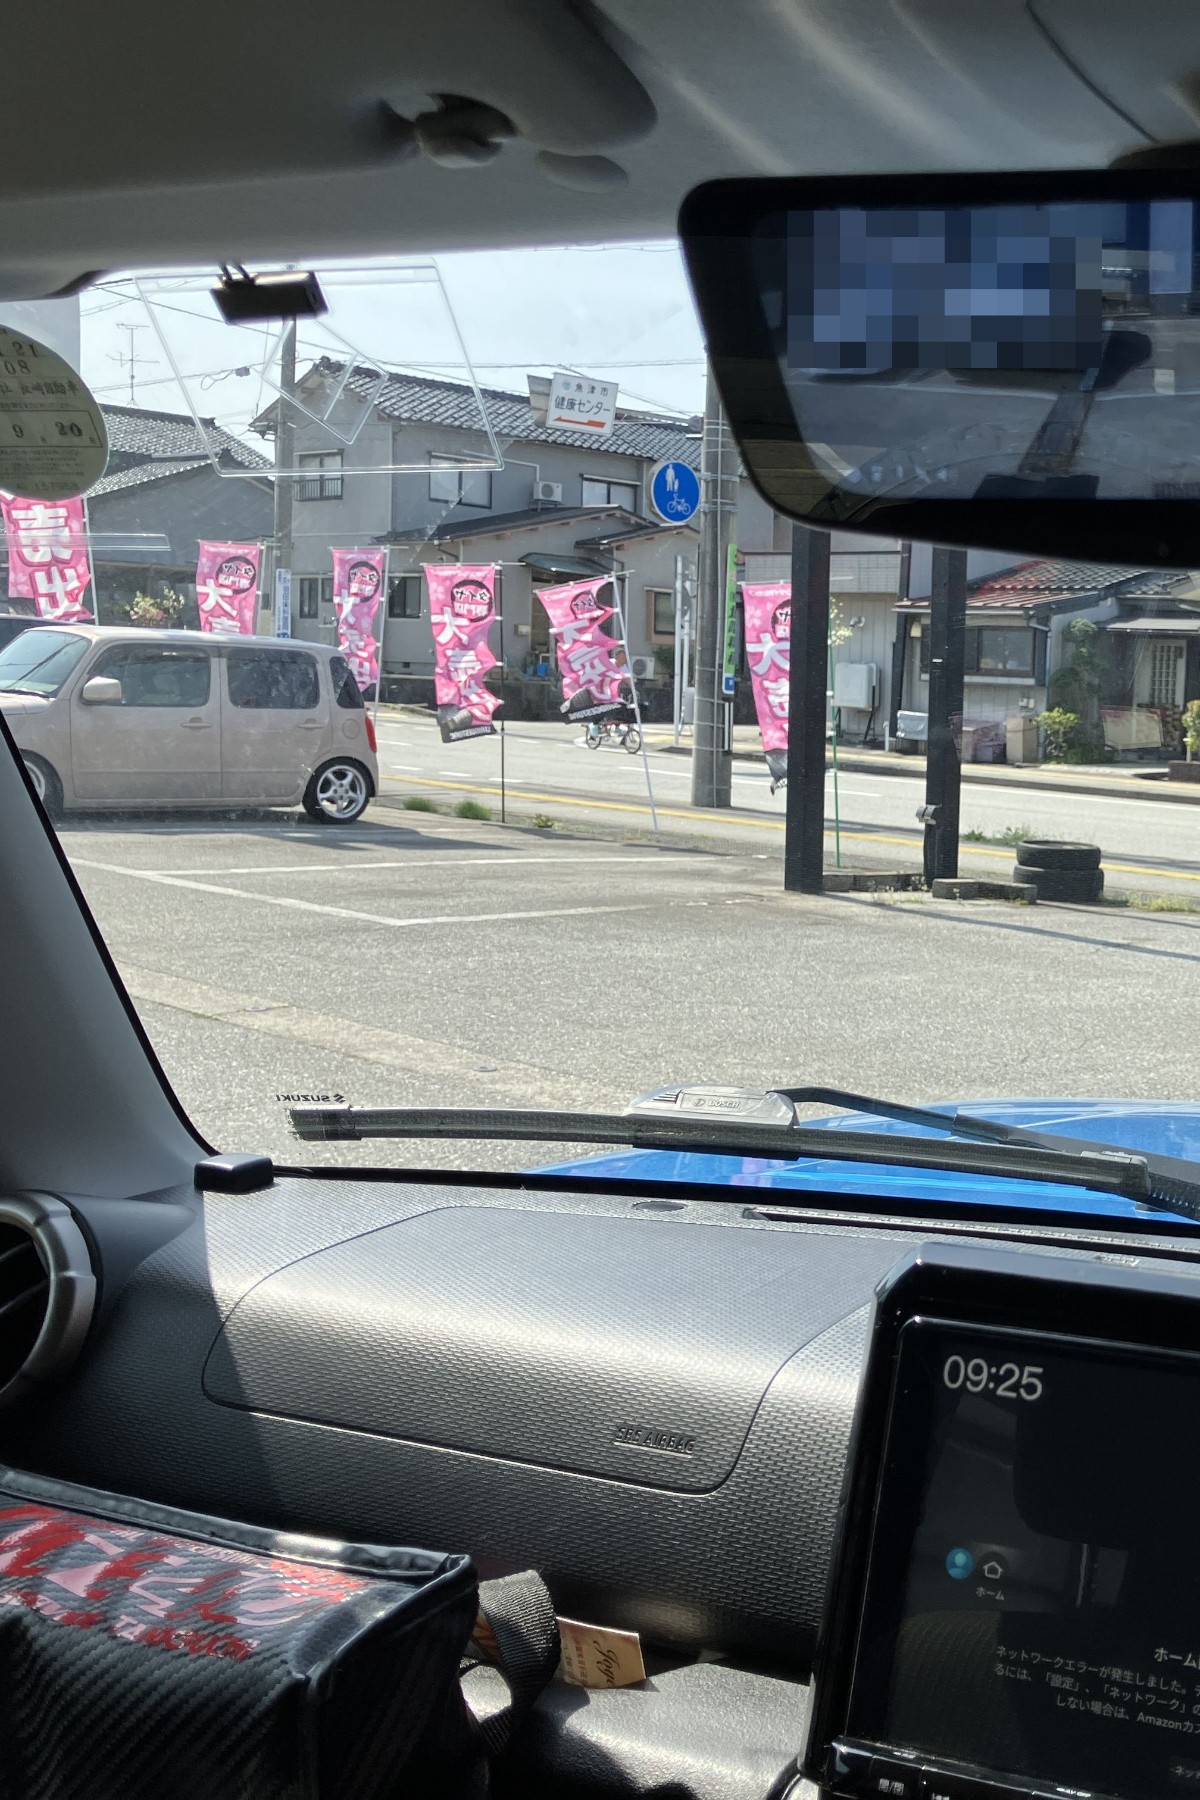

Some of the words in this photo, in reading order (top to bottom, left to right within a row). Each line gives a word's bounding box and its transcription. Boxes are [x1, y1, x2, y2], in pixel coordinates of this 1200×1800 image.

[575, 382, 609, 397] 魚津市
[555, 396, 611, 414] 健康センター
[707, 1099, 741, 1109] BOSCH
[943, 1354, 1044, 1401] 09:25
[643, 1431, 696, 1454] AIRBAG
[976, 1586, 1005, 1601] ホーム
